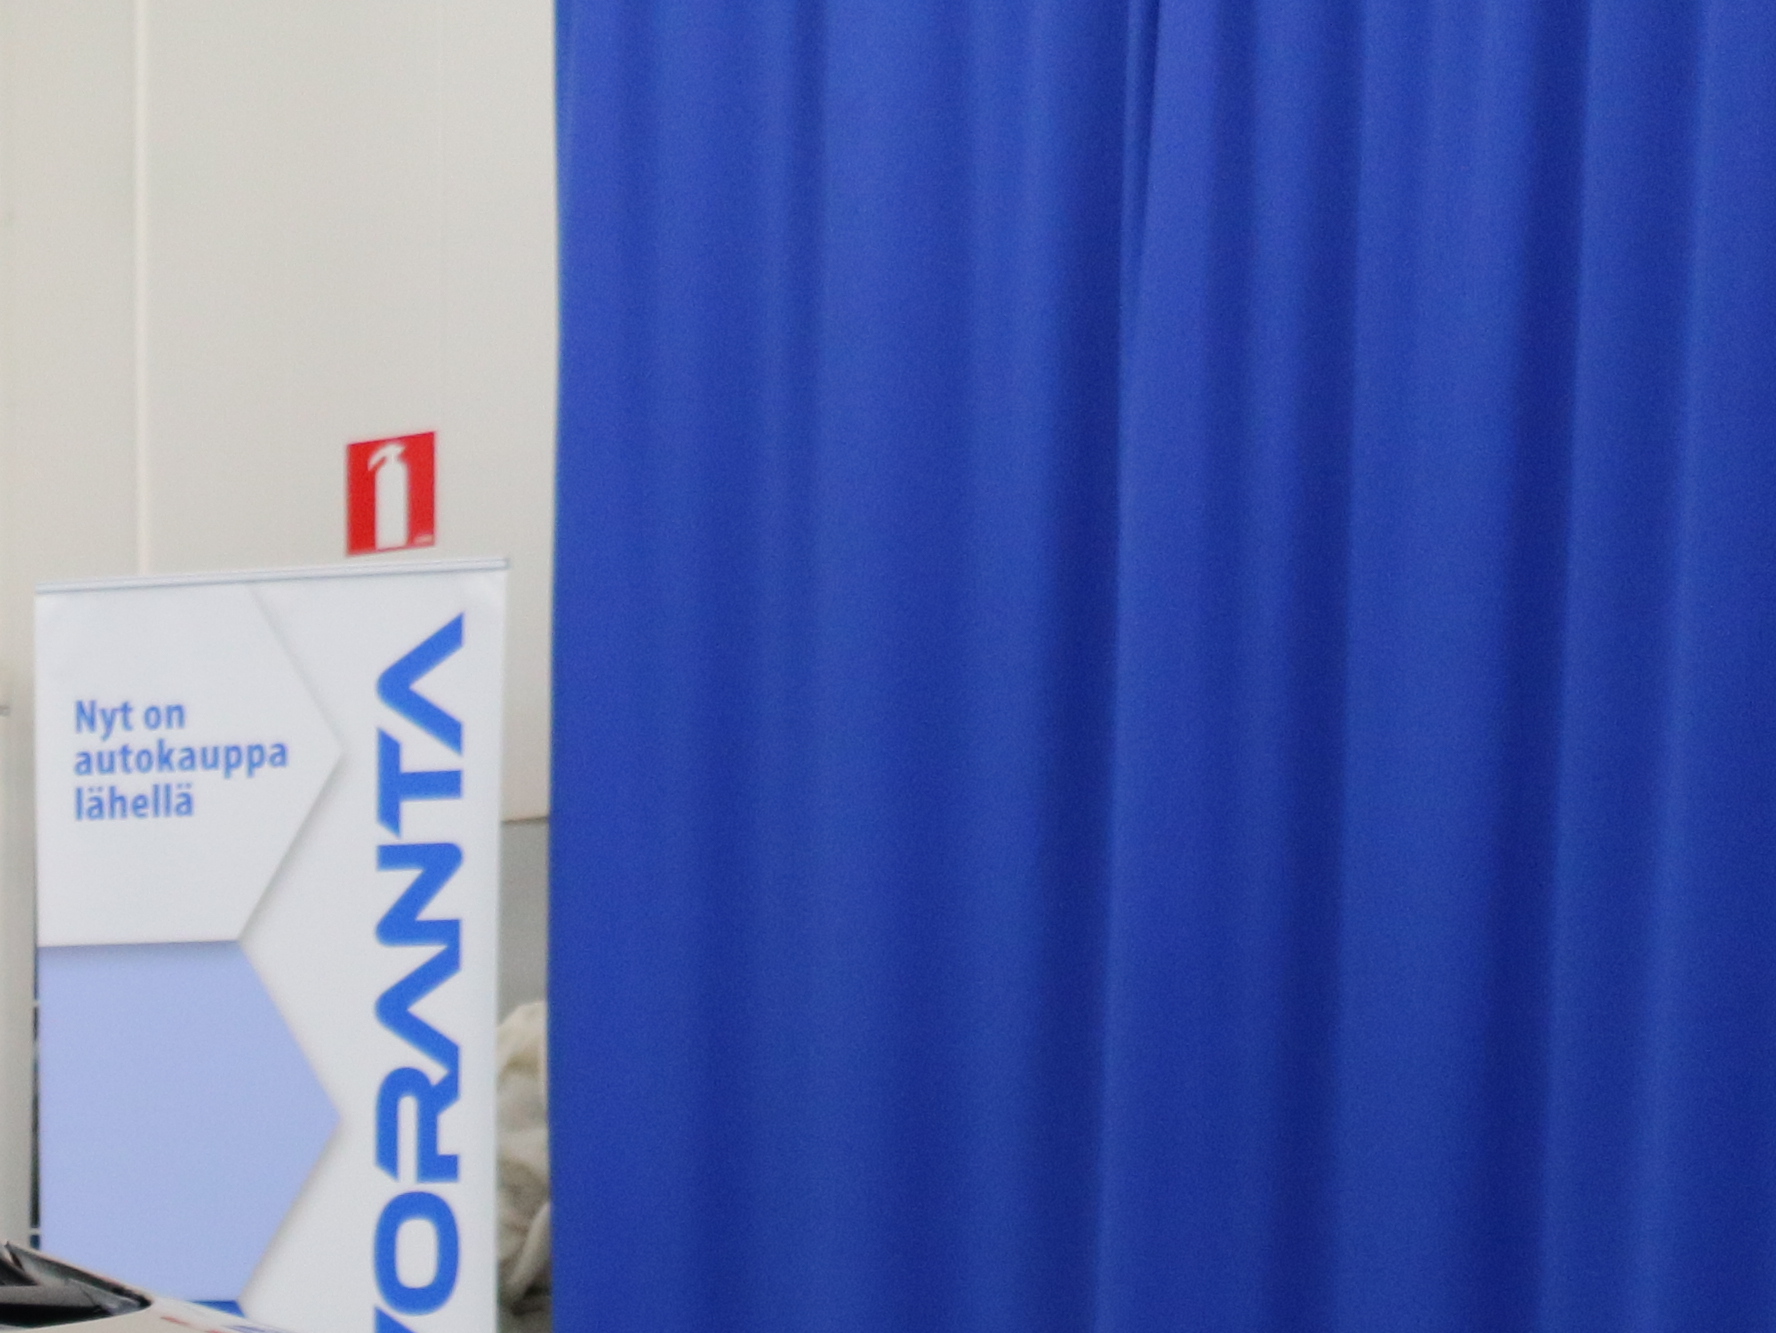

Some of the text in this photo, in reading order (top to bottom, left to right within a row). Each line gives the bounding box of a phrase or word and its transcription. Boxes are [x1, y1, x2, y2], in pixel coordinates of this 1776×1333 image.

[75, 699, 186, 741] Nyt on
[74, 737, 289, 779] autokauppa
[75, 782, 195, 821] lähellä
